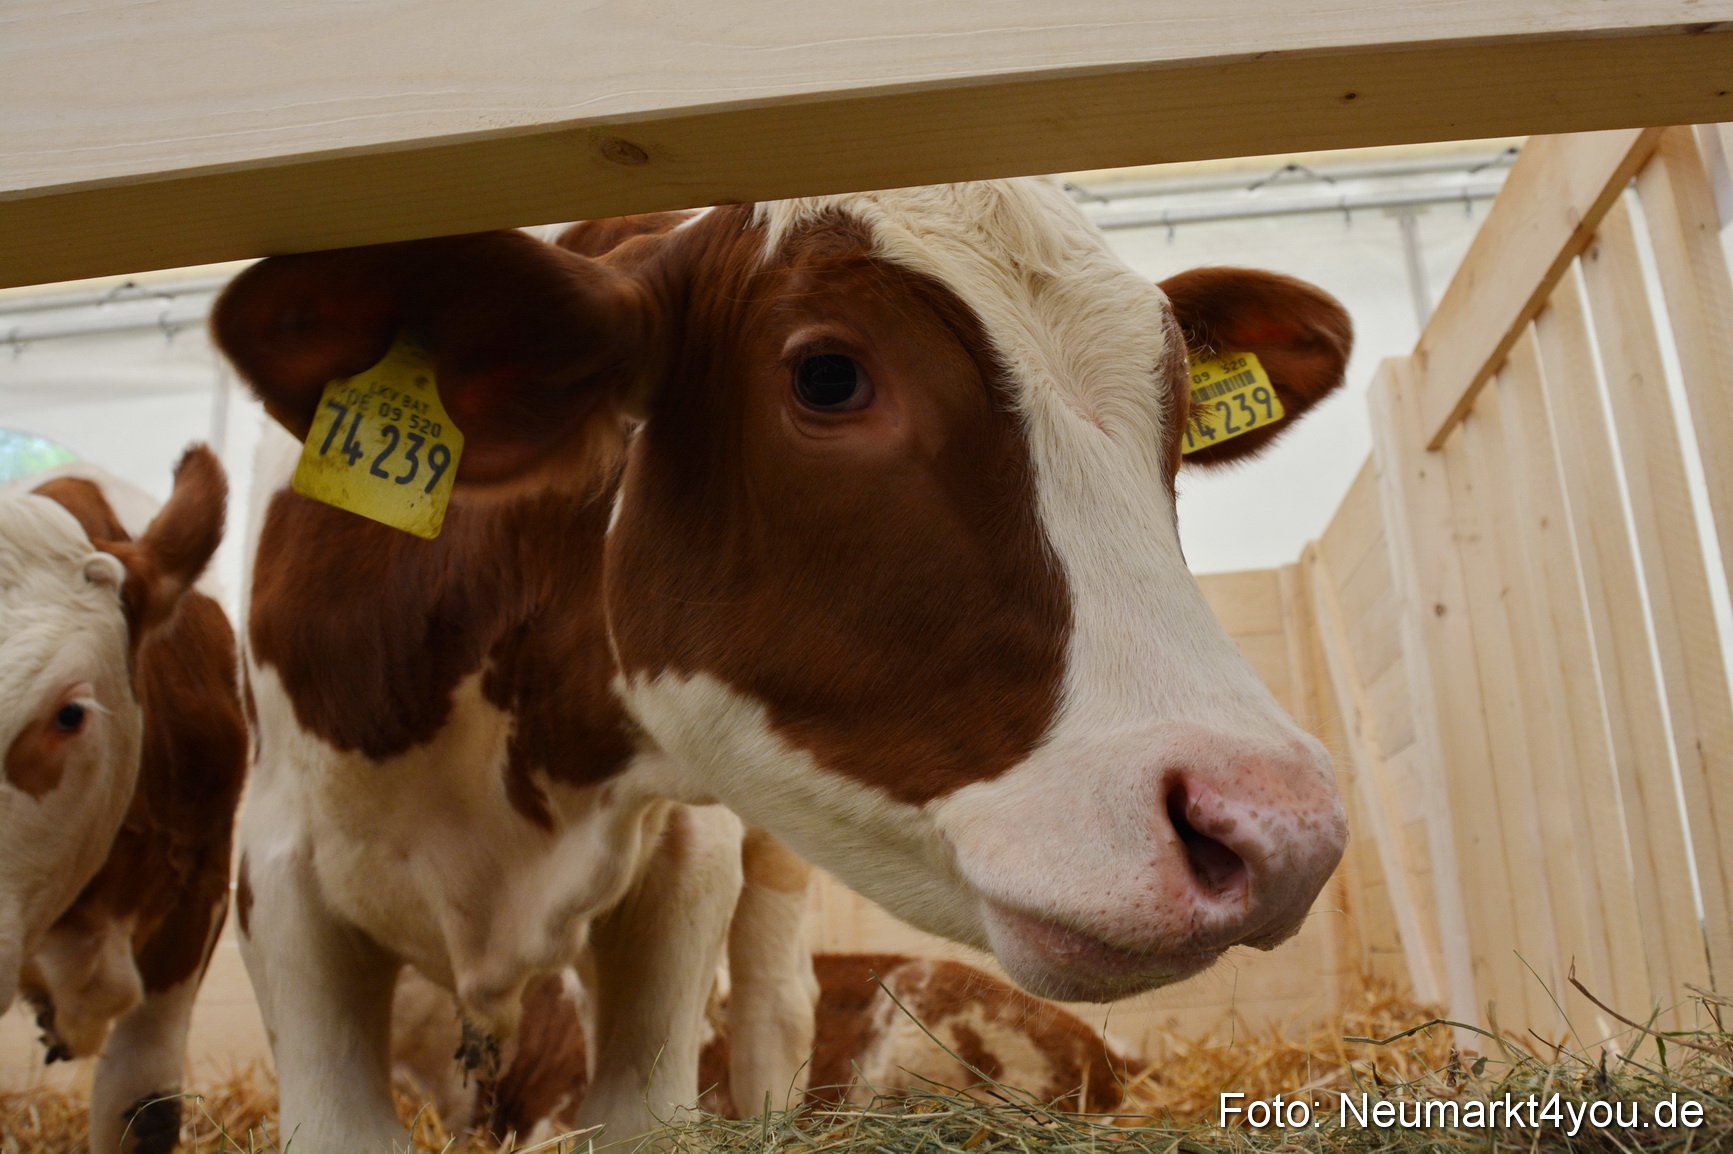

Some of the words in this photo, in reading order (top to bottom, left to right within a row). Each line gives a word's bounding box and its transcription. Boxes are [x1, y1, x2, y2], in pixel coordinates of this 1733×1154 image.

[1192, 372, 1210, 384] 09
[1220, 358, 1247, 374] 520
[378, 402, 404, 422] 09
[408, 414, 442, 438] 520
[1215, 386, 1272, 434] 239
[319, 399, 364, 467] 74
[369, 423, 451, 494] 239
